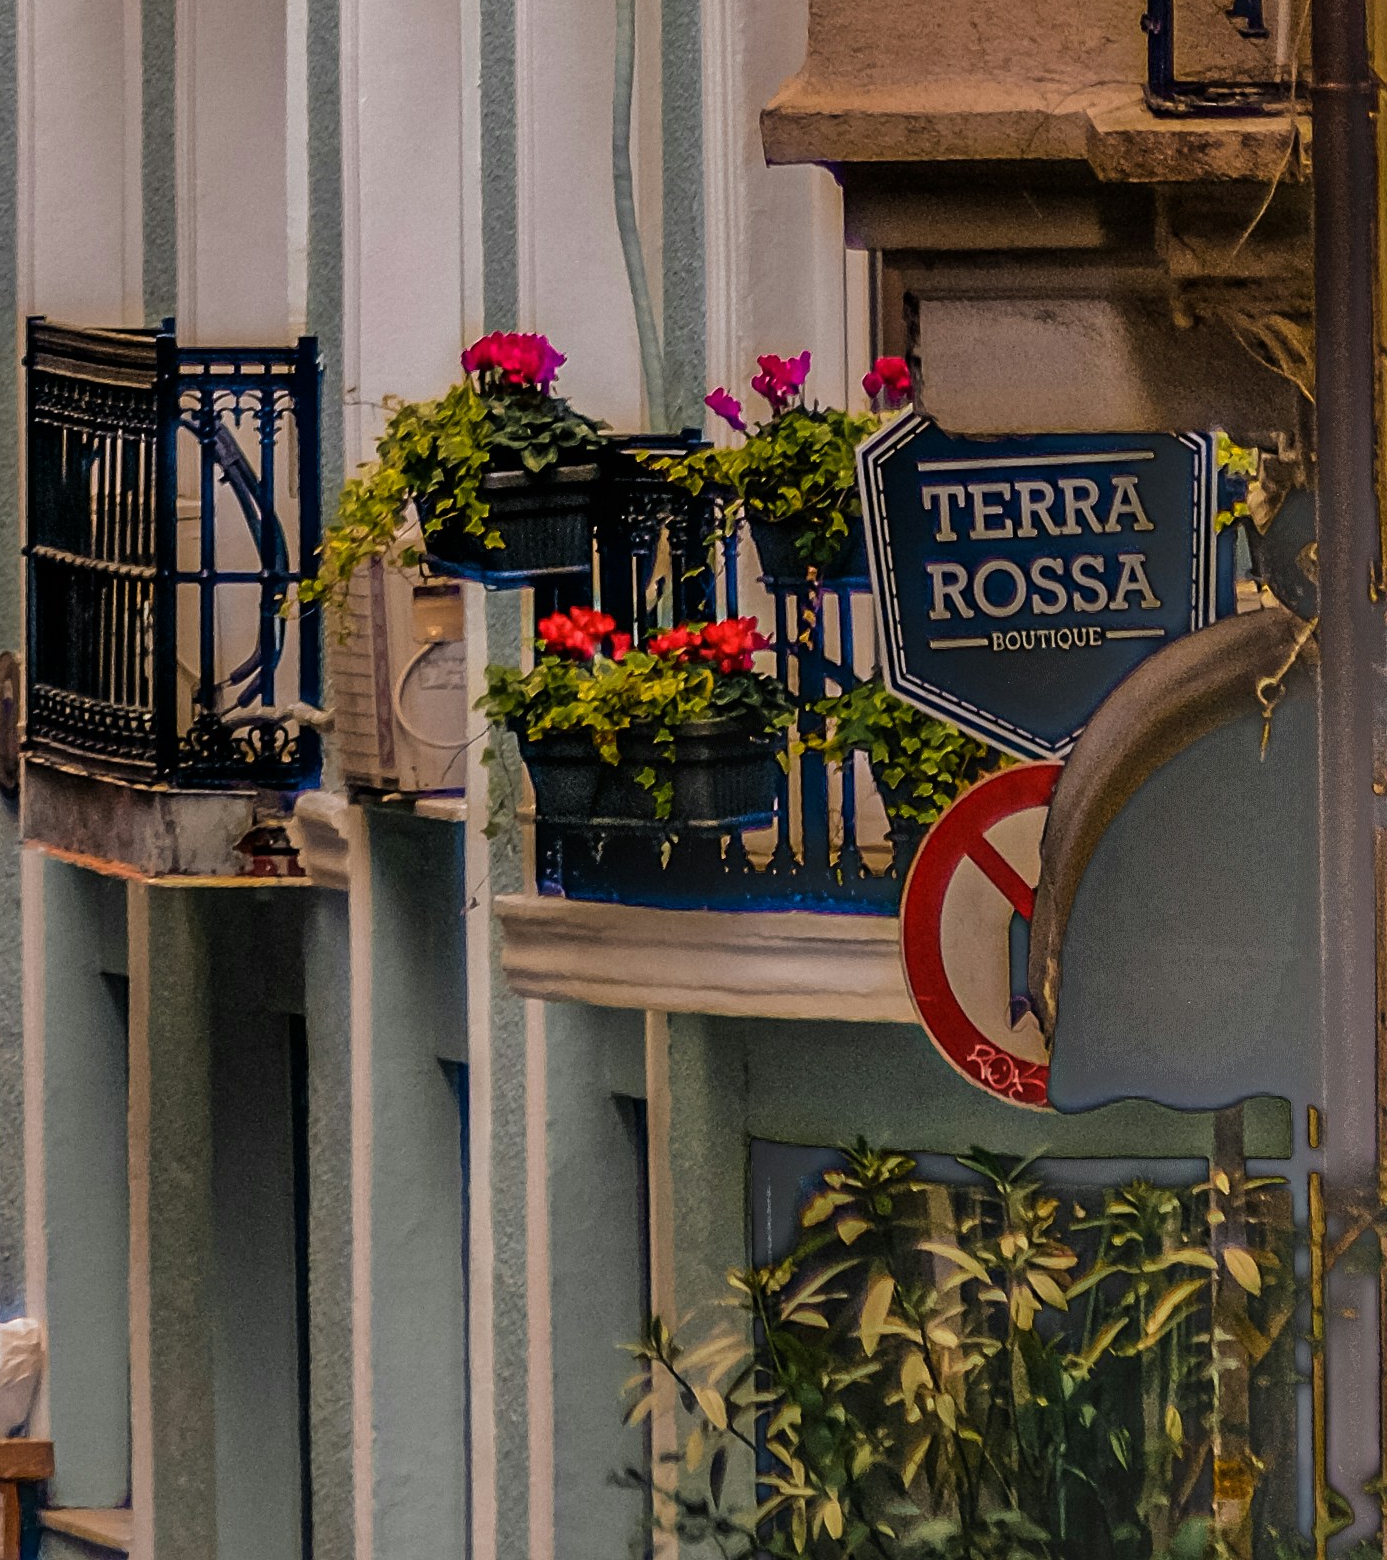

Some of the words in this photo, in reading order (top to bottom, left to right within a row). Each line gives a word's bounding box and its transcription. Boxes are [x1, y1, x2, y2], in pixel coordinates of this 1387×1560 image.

[921, 474, 1155, 544] TERRA
[927, 552, 1162, 621] ROSSA
[991, 625, 1103, 653] BOUTIQUE
